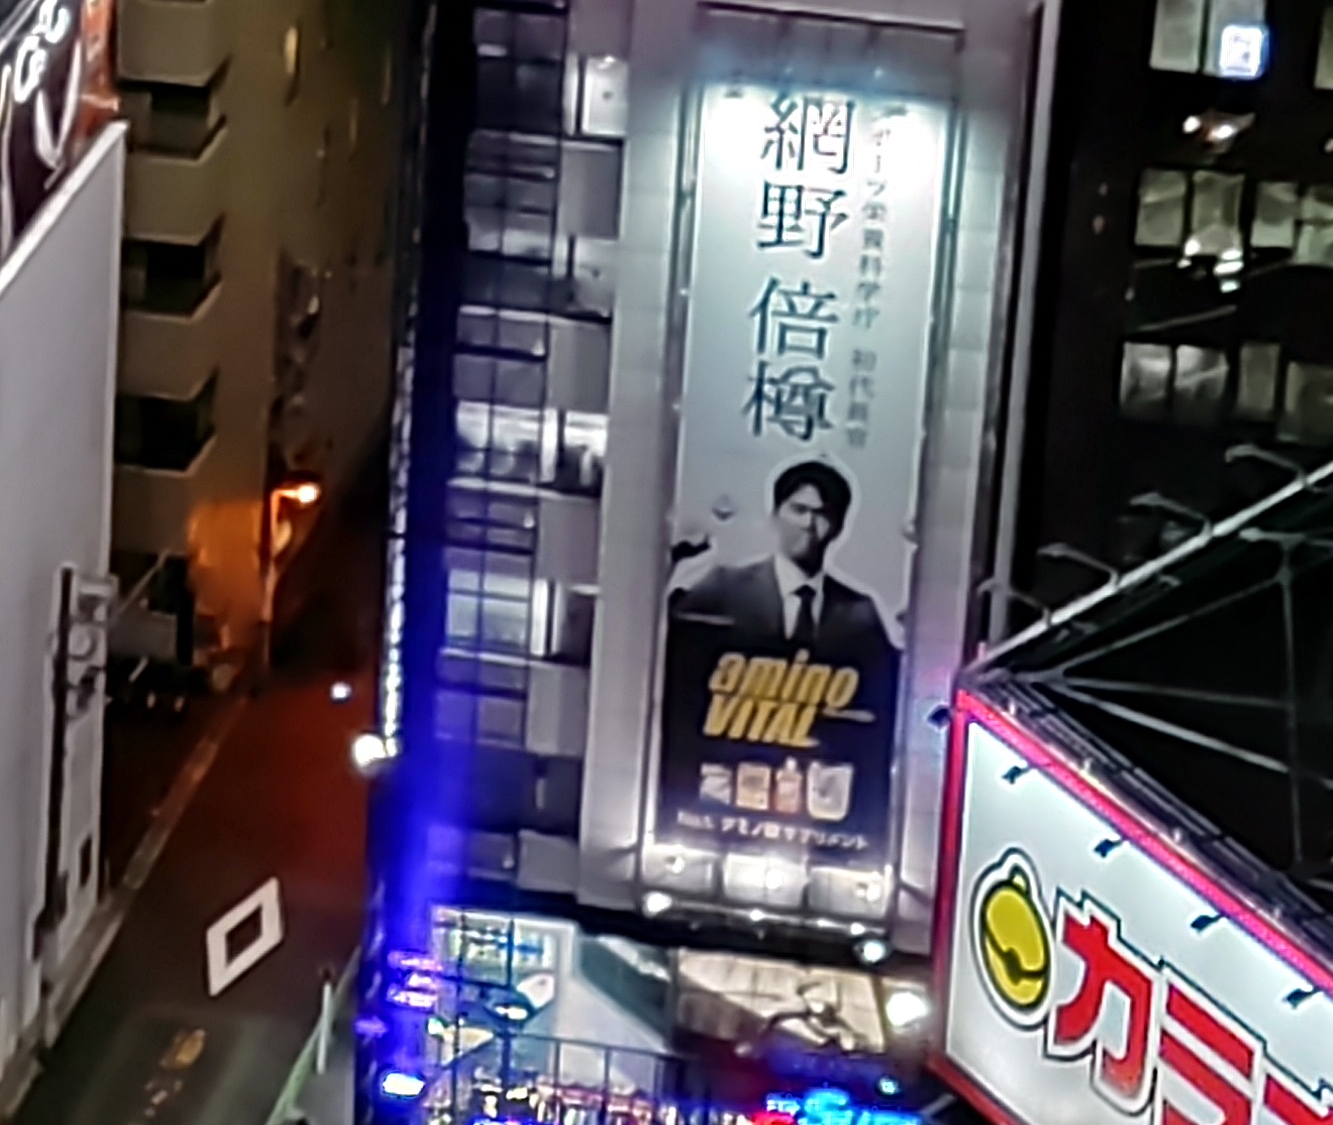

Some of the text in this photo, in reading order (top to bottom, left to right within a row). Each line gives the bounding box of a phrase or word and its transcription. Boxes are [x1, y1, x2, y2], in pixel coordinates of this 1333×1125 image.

[757, 91, 856, 259] 網野
[708, 648, 860, 709] amino
[702, 693, 821, 748] VITAL
